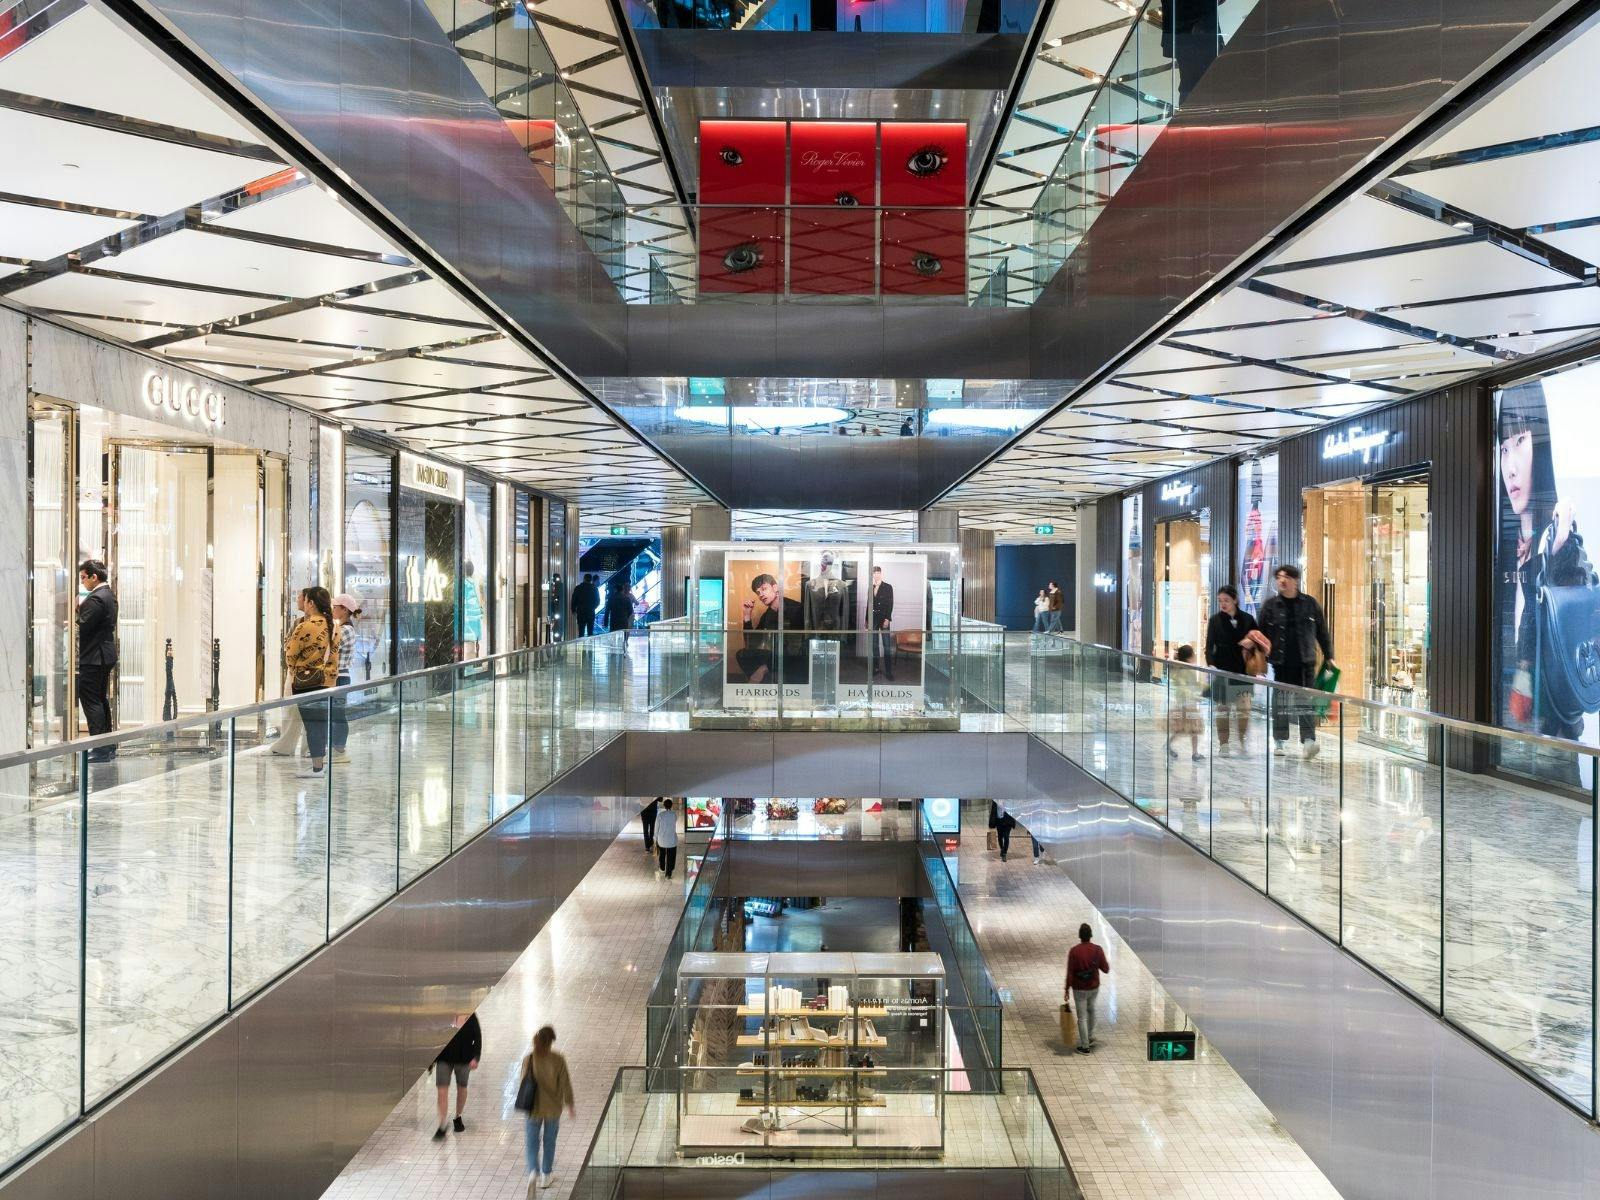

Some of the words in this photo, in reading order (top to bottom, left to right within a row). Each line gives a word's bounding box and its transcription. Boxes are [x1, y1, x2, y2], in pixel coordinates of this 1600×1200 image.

[800, 150, 833, 173] Roger
[833, 151, 865, 167] Vivier
[146, 373, 226, 425] GUCCI
[735, 688, 800, 697] HARRODS
[848, 689, 913, 698] HAROLDS
